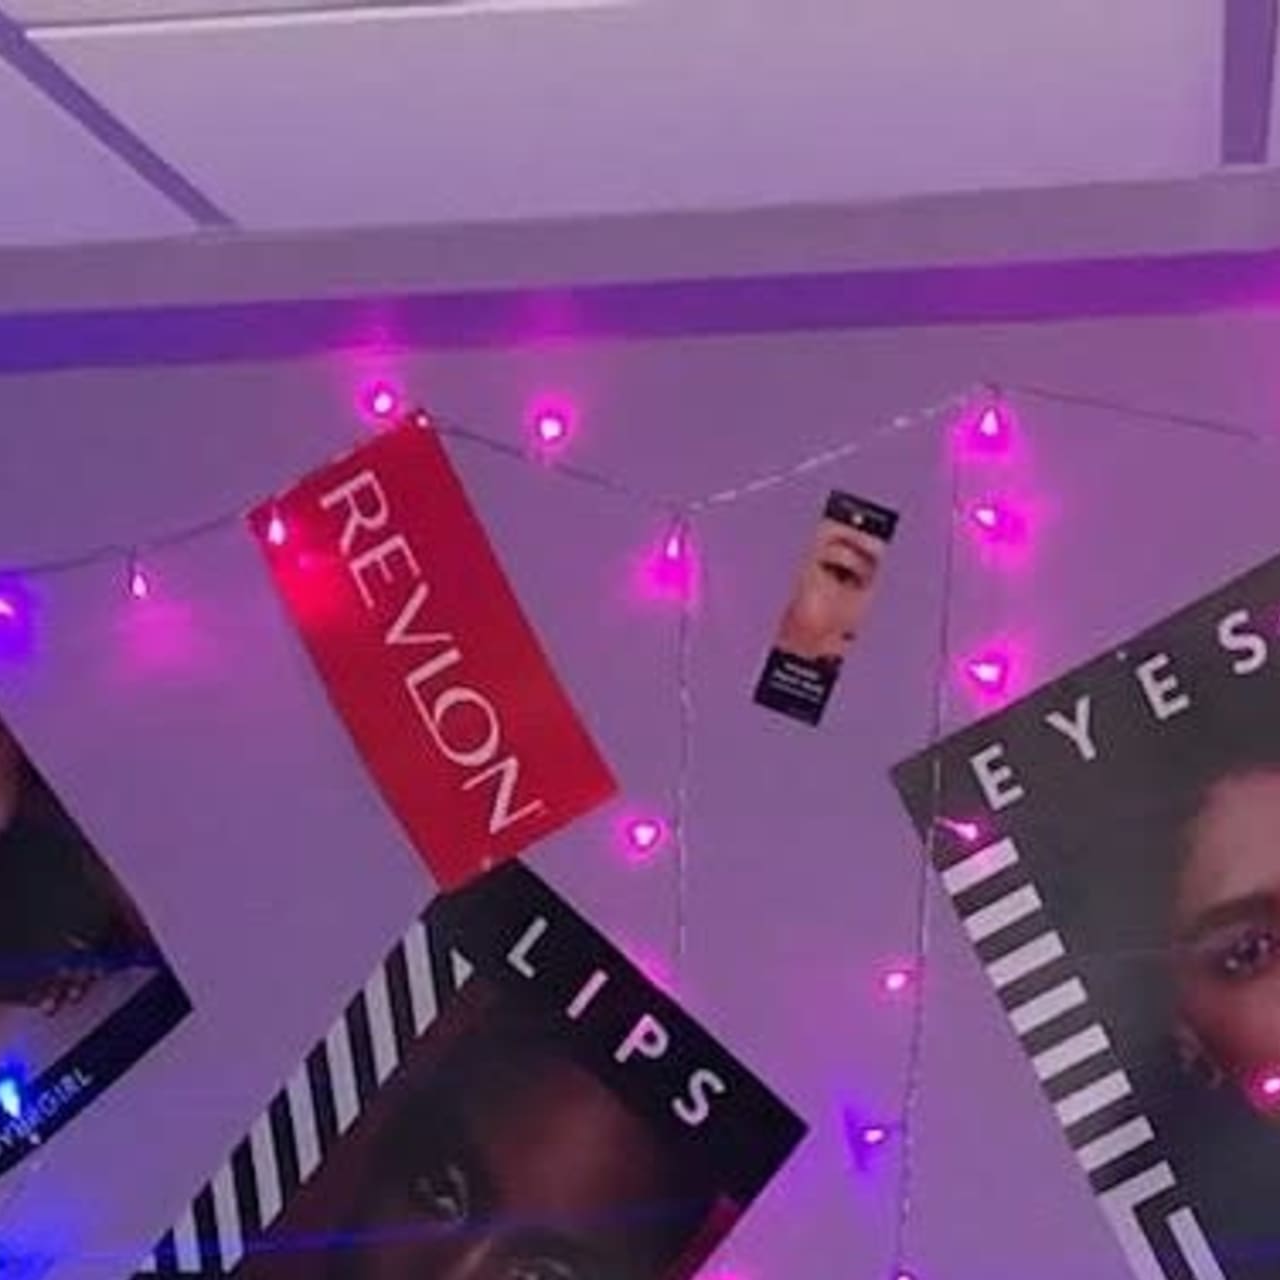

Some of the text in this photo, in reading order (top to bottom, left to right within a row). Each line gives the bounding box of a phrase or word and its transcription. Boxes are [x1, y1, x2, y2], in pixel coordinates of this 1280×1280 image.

[319, 470, 544, 834] REVLON
[969, 608, 1269, 812] EYES
[506, 916, 726, 1126] LIPS
